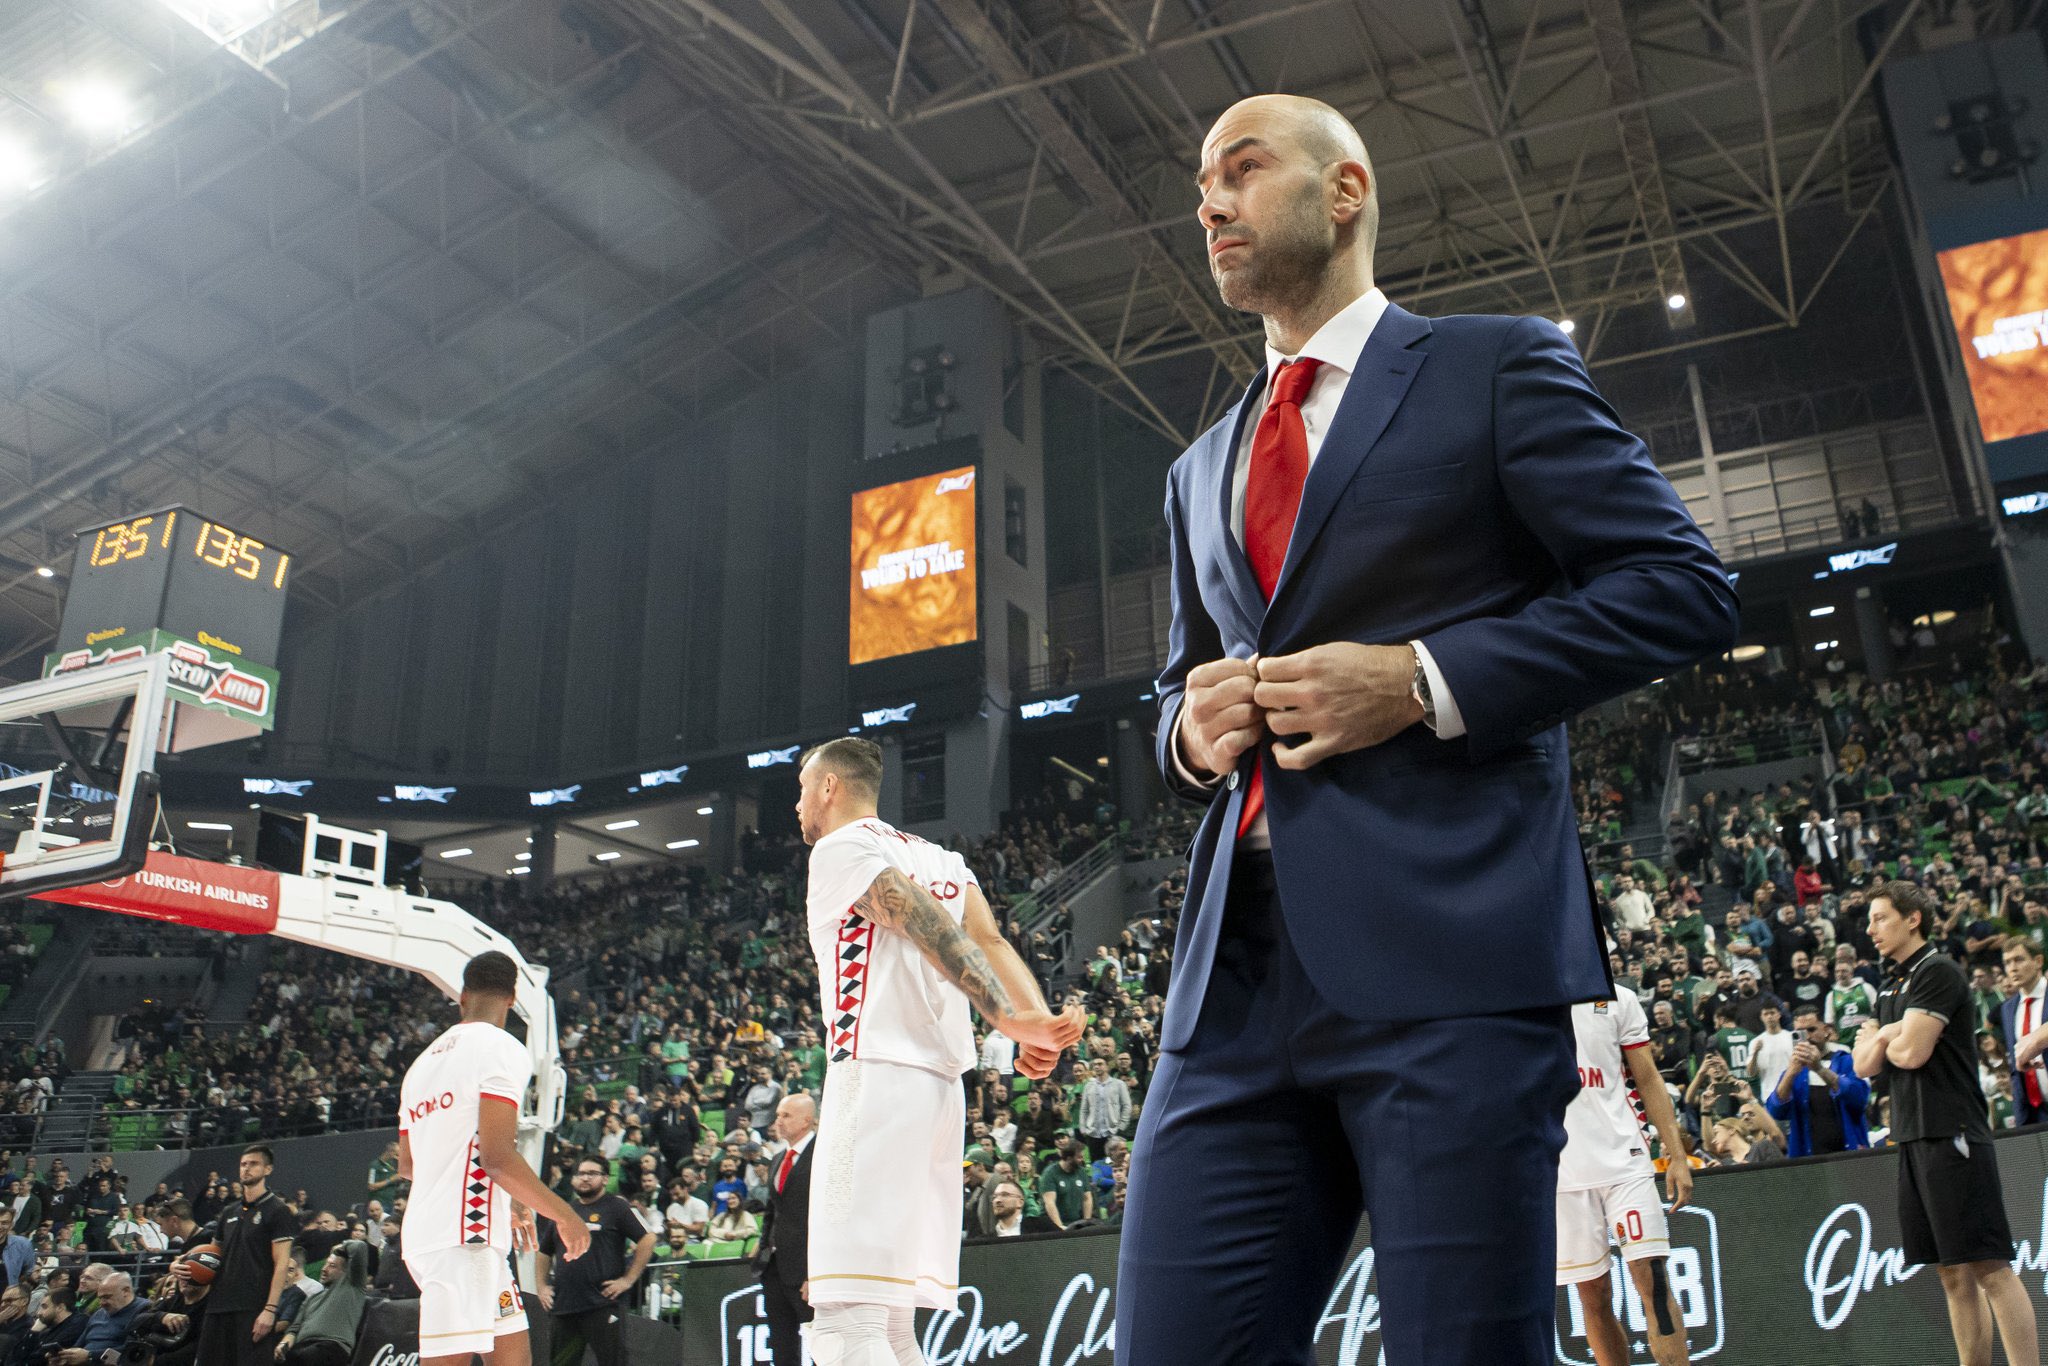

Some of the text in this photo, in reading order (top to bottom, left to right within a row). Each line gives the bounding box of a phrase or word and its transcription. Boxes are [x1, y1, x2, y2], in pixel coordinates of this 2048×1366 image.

[195, 522, 289, 589] 13:51
[135, 870, 269, 910] TURKISH AIRLINES
[1626, 1210, 1643, 1241] 0
[1803, 1203, 1927, 1330] One
[922, 1286, 1029, 1366] One
